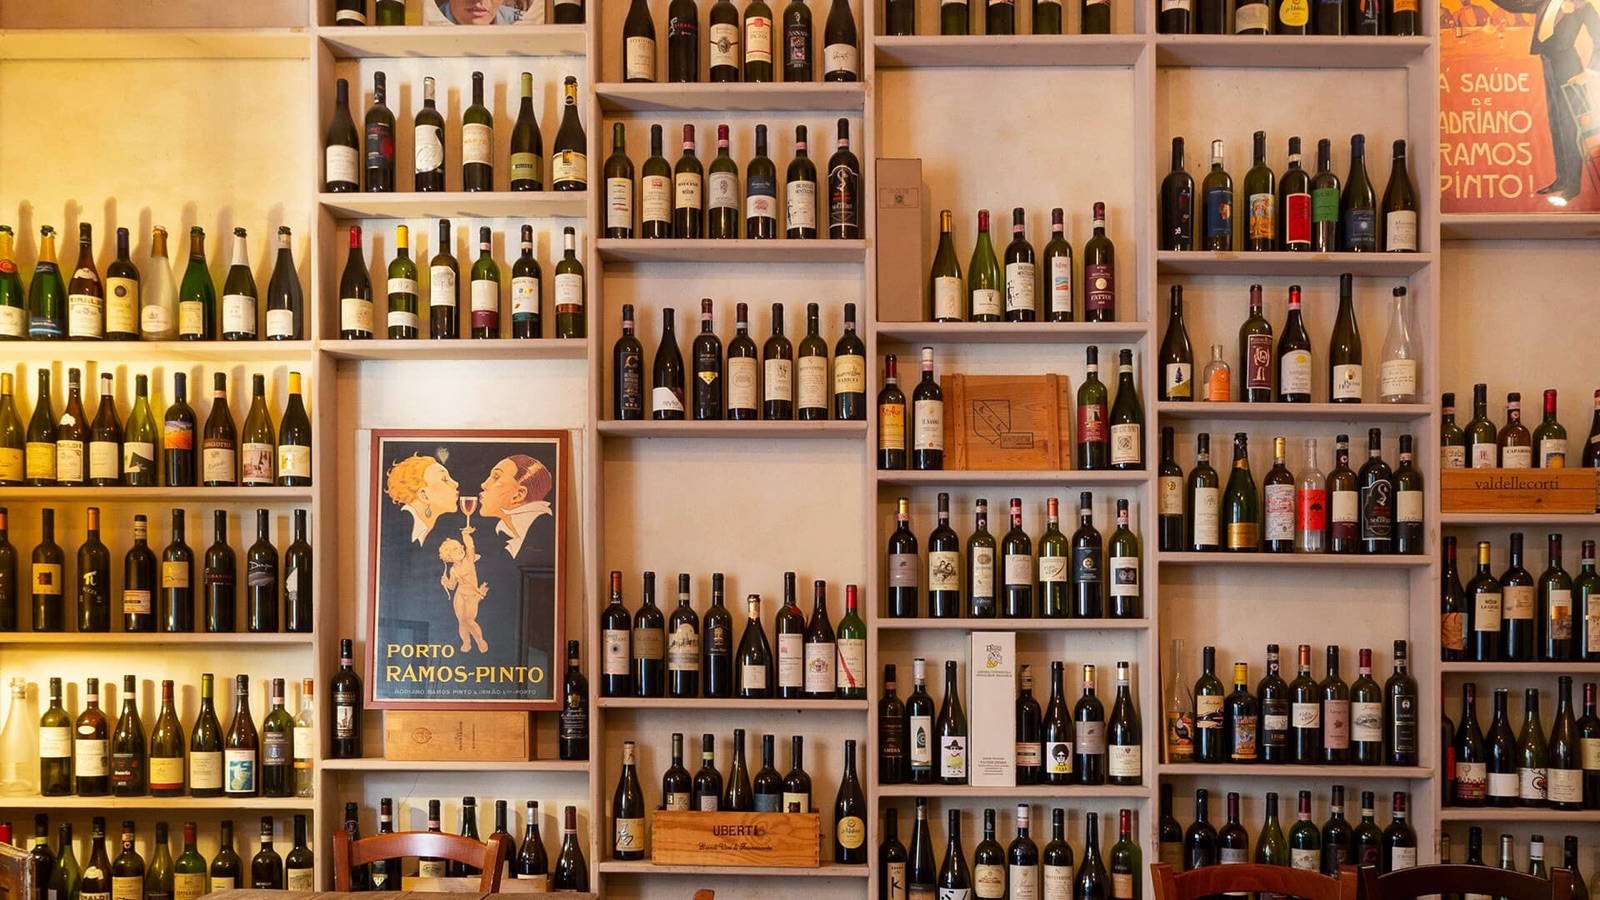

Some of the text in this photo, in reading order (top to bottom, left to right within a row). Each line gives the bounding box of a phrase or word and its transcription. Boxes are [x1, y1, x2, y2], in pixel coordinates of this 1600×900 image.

[1460, 66, 1530, 93] SAÚDE
[1471, 97, 1493, 106] DE
[1440, 108, 1532, 134] ADRIANO
[1440, 142, 1533, 166] RAMOS
[1474, 476, 1559, 490] valdellecorti
[387, 644, 455, 658] PORTO
[386, 665, 544, 683] RAMOS-PINTO
[712, 825, 758, 836] UBERTI
